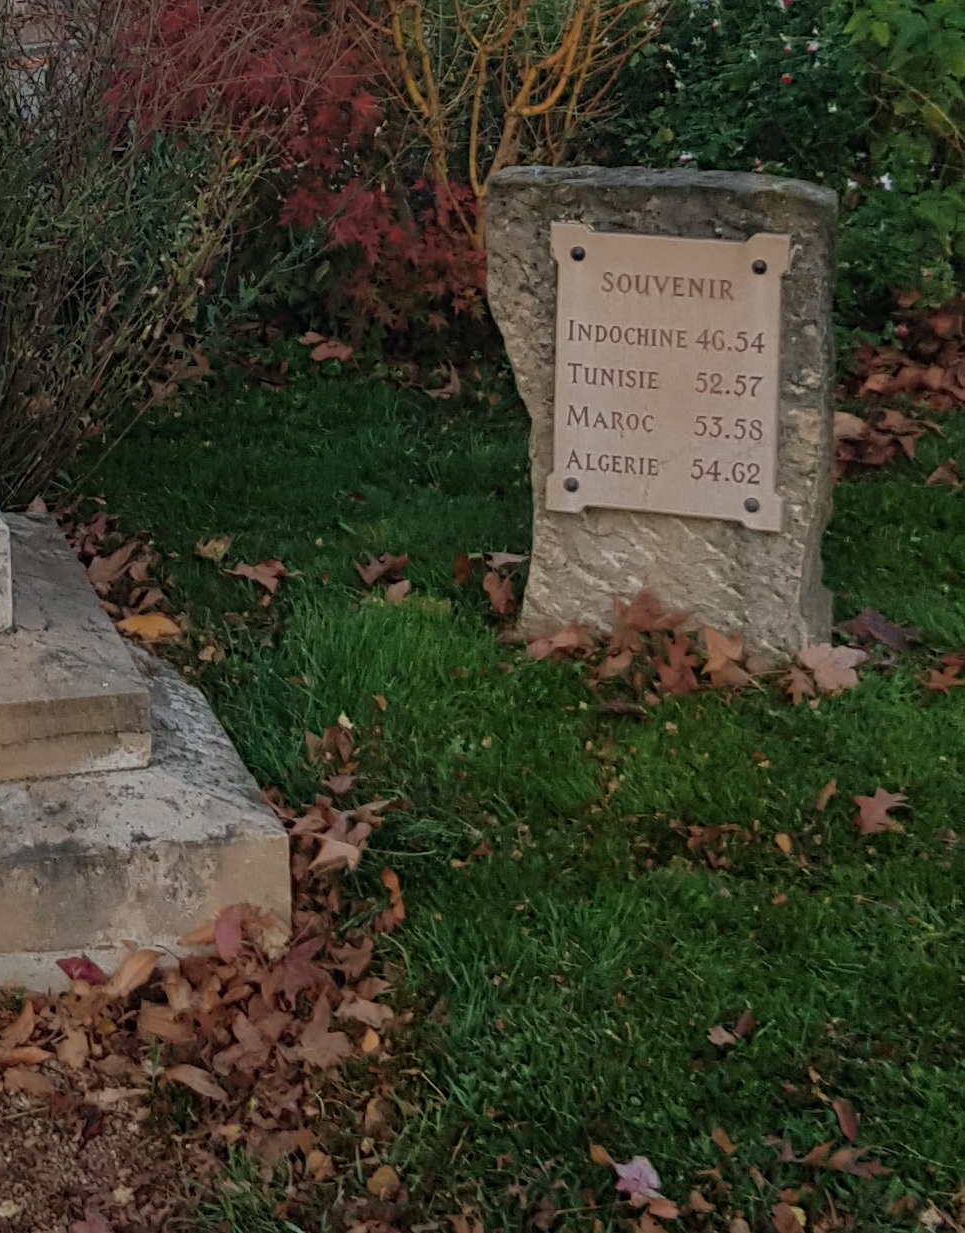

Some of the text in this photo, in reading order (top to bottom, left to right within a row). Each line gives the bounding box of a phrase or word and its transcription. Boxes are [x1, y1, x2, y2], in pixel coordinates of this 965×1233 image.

[600, 271, 735, 301] SOUVENIR
[567, 319, 765, 354] INDOCHINE 46.54
[567, 362, 764, 397] TUNISIE 52.57
[566, 405, 764, 441] MAROC 53.58
[565, 449, 761, 485] ALGERIE 54.62
